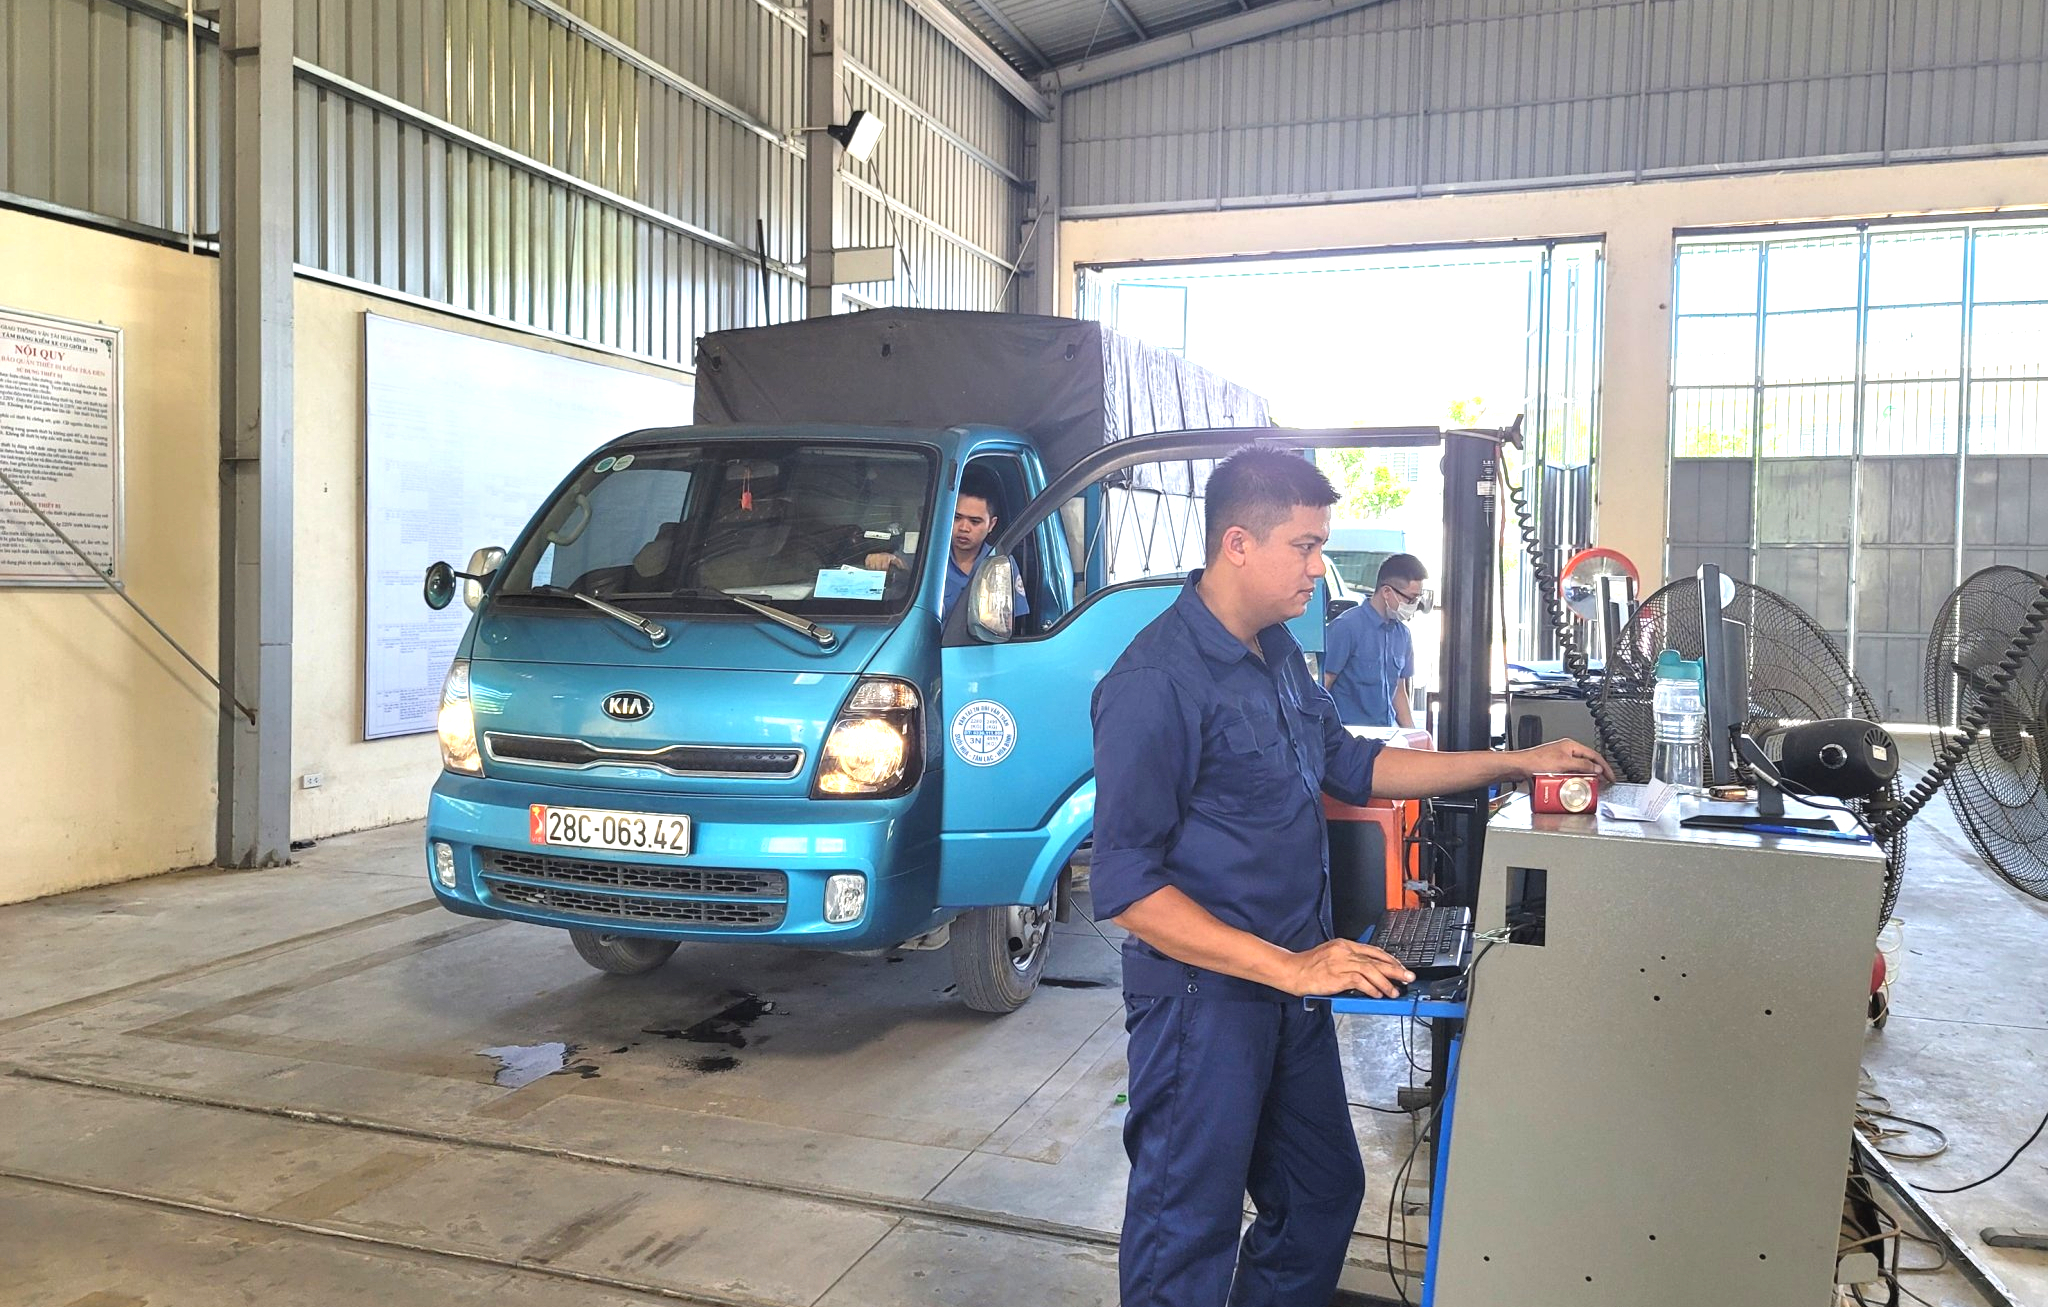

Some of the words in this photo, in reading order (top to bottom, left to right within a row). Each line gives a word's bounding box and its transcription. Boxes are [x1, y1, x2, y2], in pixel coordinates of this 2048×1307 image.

[15, 344, 37, 358] NỘI
[40, 348, 65, 361] QUY
[609, 697, 644, 715] KIA
[969, 737, 982, 745] 3N
[549, 812, 684, 851] 28C-063.42
